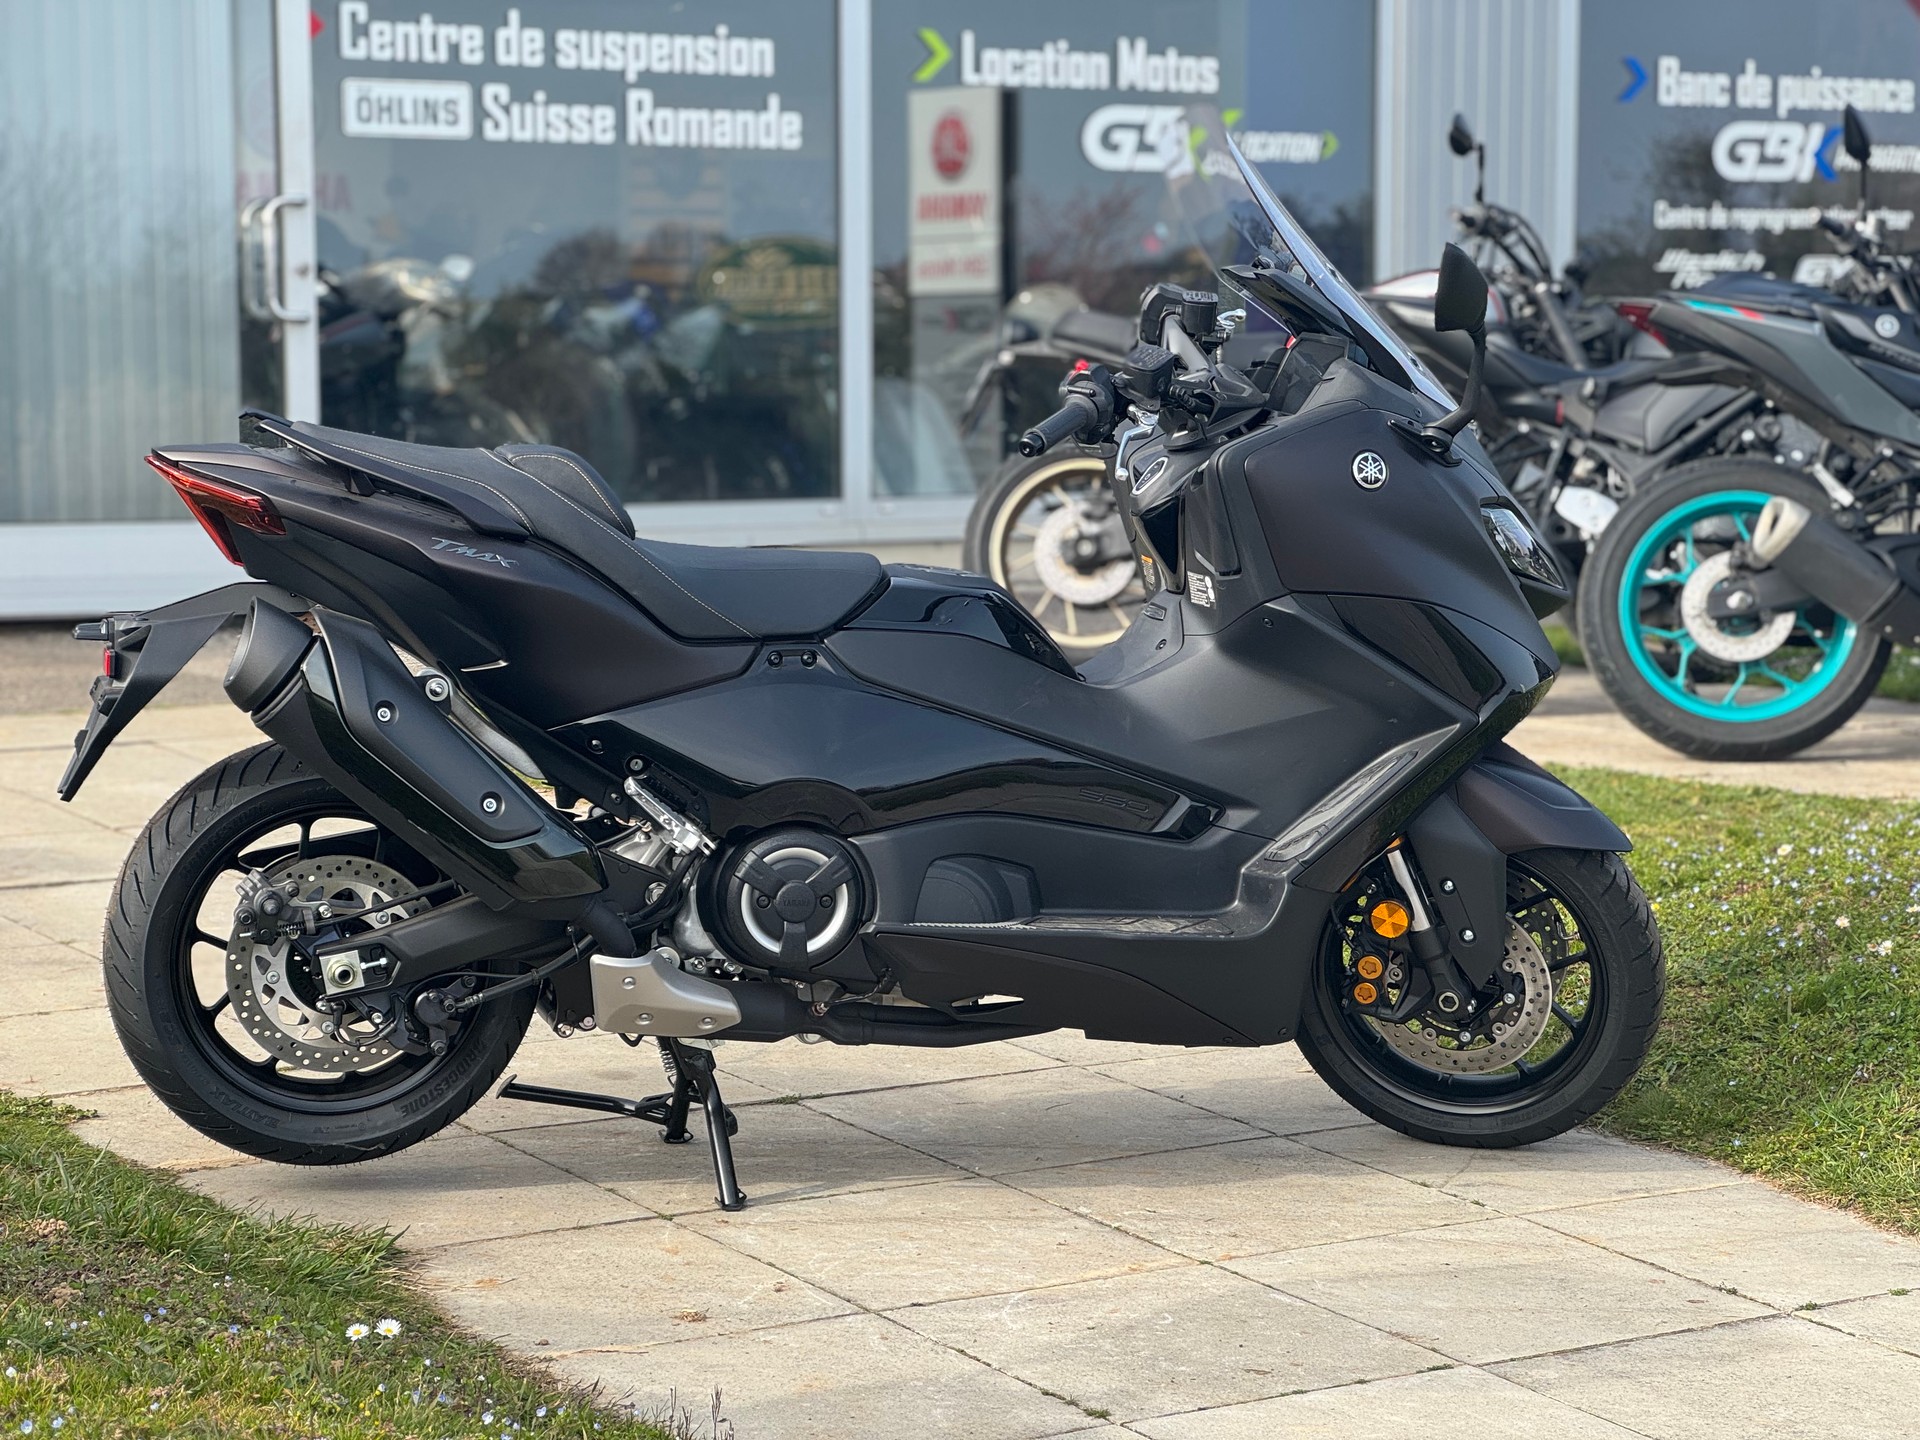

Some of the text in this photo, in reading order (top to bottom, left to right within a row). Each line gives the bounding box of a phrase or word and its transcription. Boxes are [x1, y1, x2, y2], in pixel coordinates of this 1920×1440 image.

[339, 1, 775, 83] Centre de suspension
[961, 30, 1219, 94] Location Motos
[355, 95, 461, 127] ÖHLINS
[481, 83, 803, 149] Suisse Romande
[1657, 55, 1915, 119] Banc de puissance
